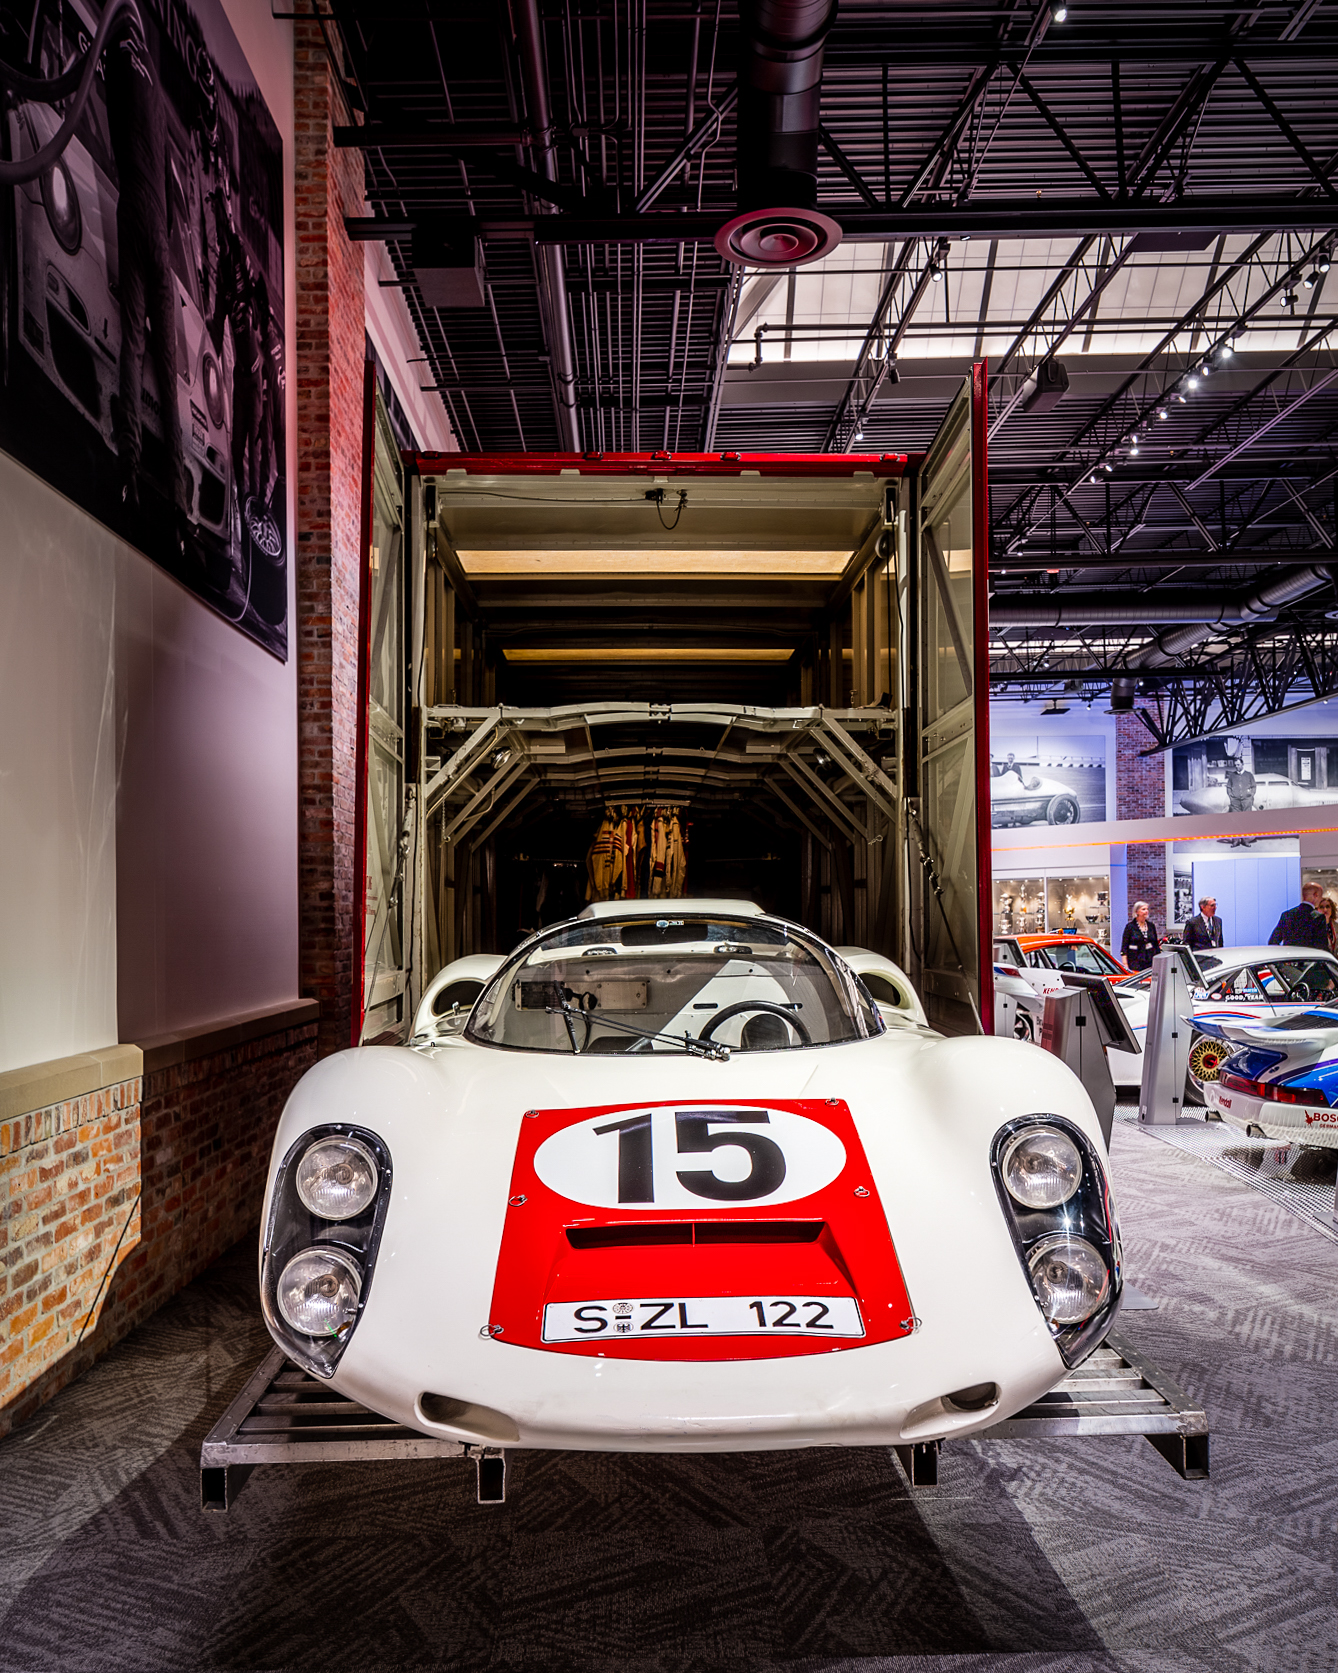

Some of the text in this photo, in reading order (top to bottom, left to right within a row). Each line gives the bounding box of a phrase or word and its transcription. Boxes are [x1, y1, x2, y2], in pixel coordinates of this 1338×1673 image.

[1313, 1112, 1338, 1123] BOS
[592, 1110, 787, 1204] 15
[748, 1300, 834, 1330] 122
